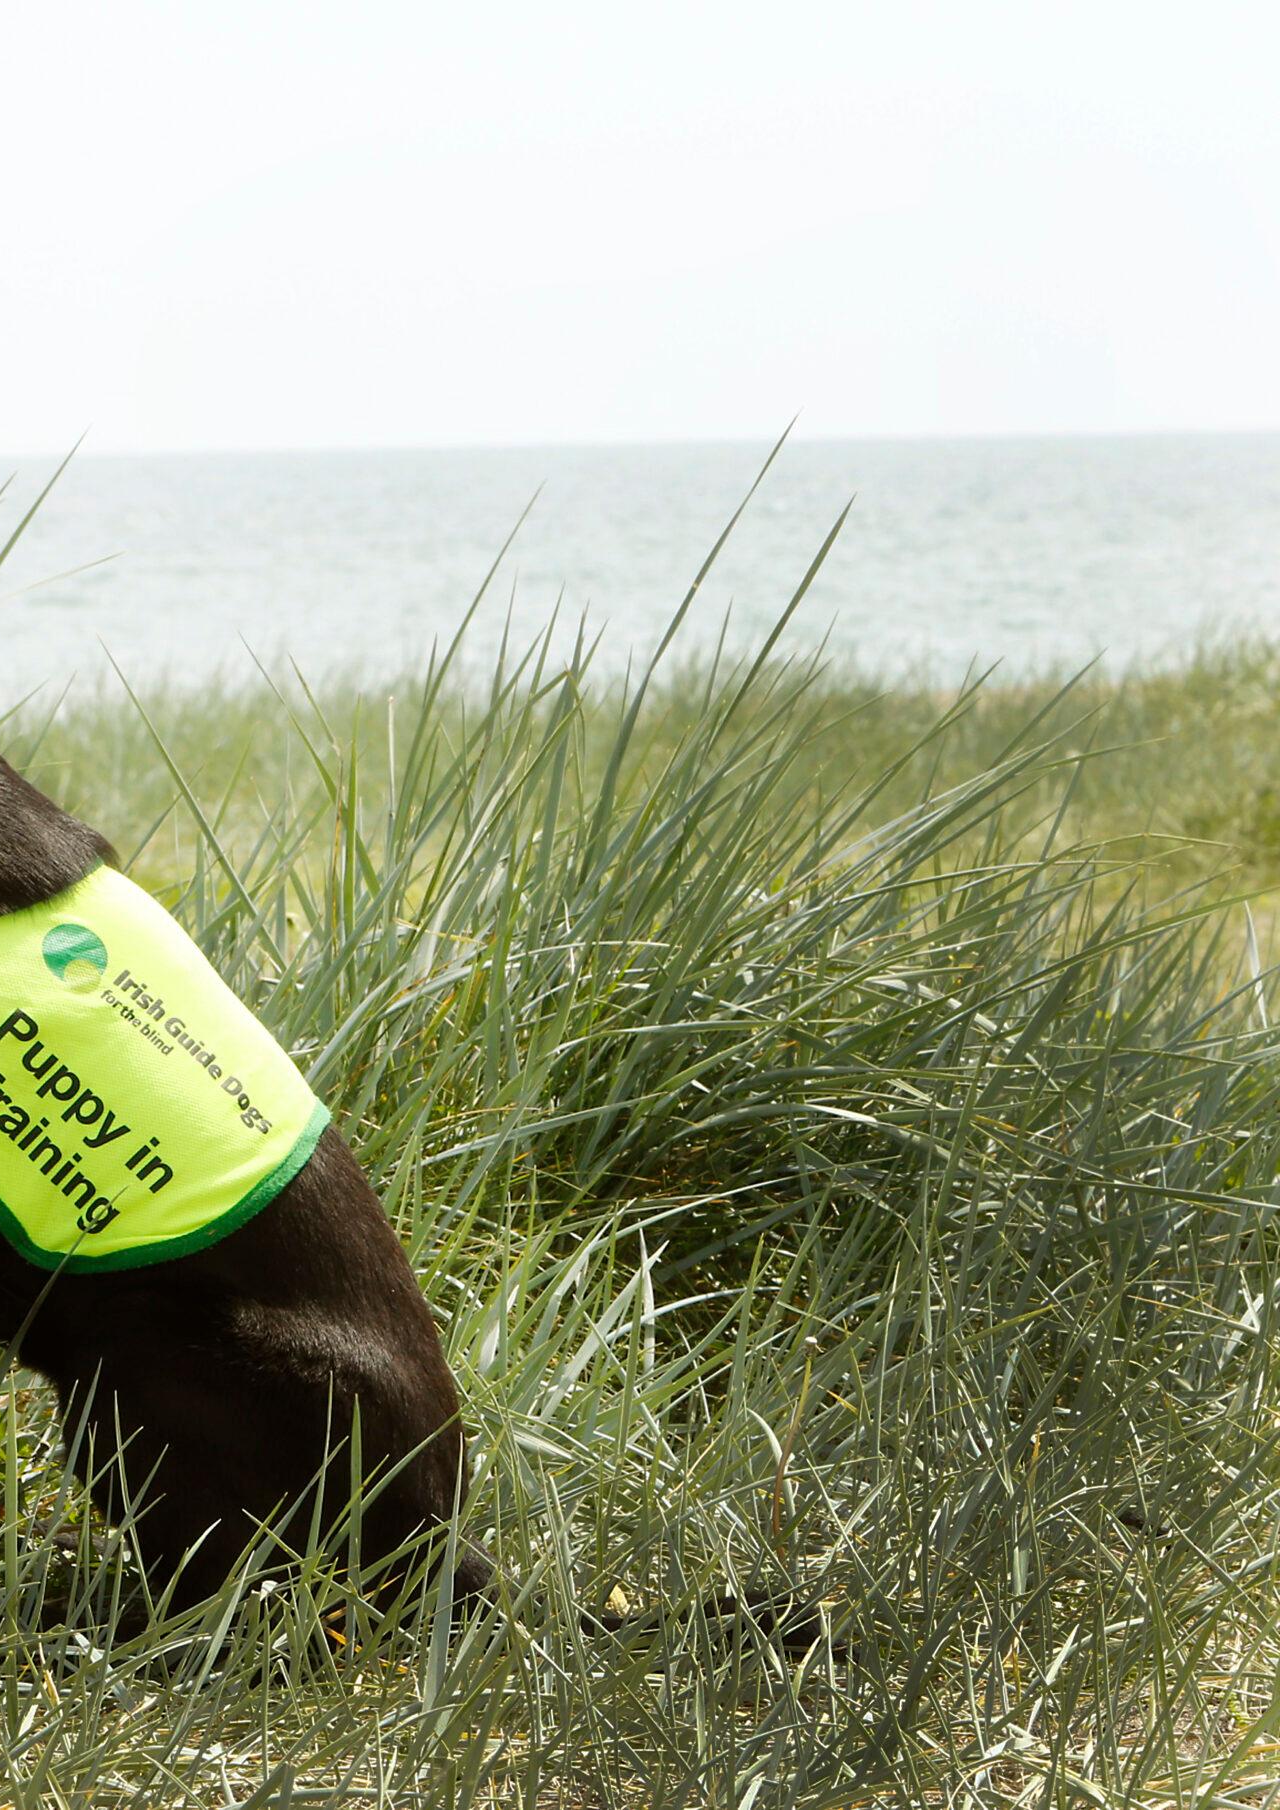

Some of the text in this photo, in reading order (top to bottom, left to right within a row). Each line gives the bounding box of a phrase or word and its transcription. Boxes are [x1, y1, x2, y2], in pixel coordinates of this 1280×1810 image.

[100, 989, 175, 1056] for the blind
[113, 970, 273, 1135] Irish Guide Dogs
[124, 1136, 174, 1194] in
